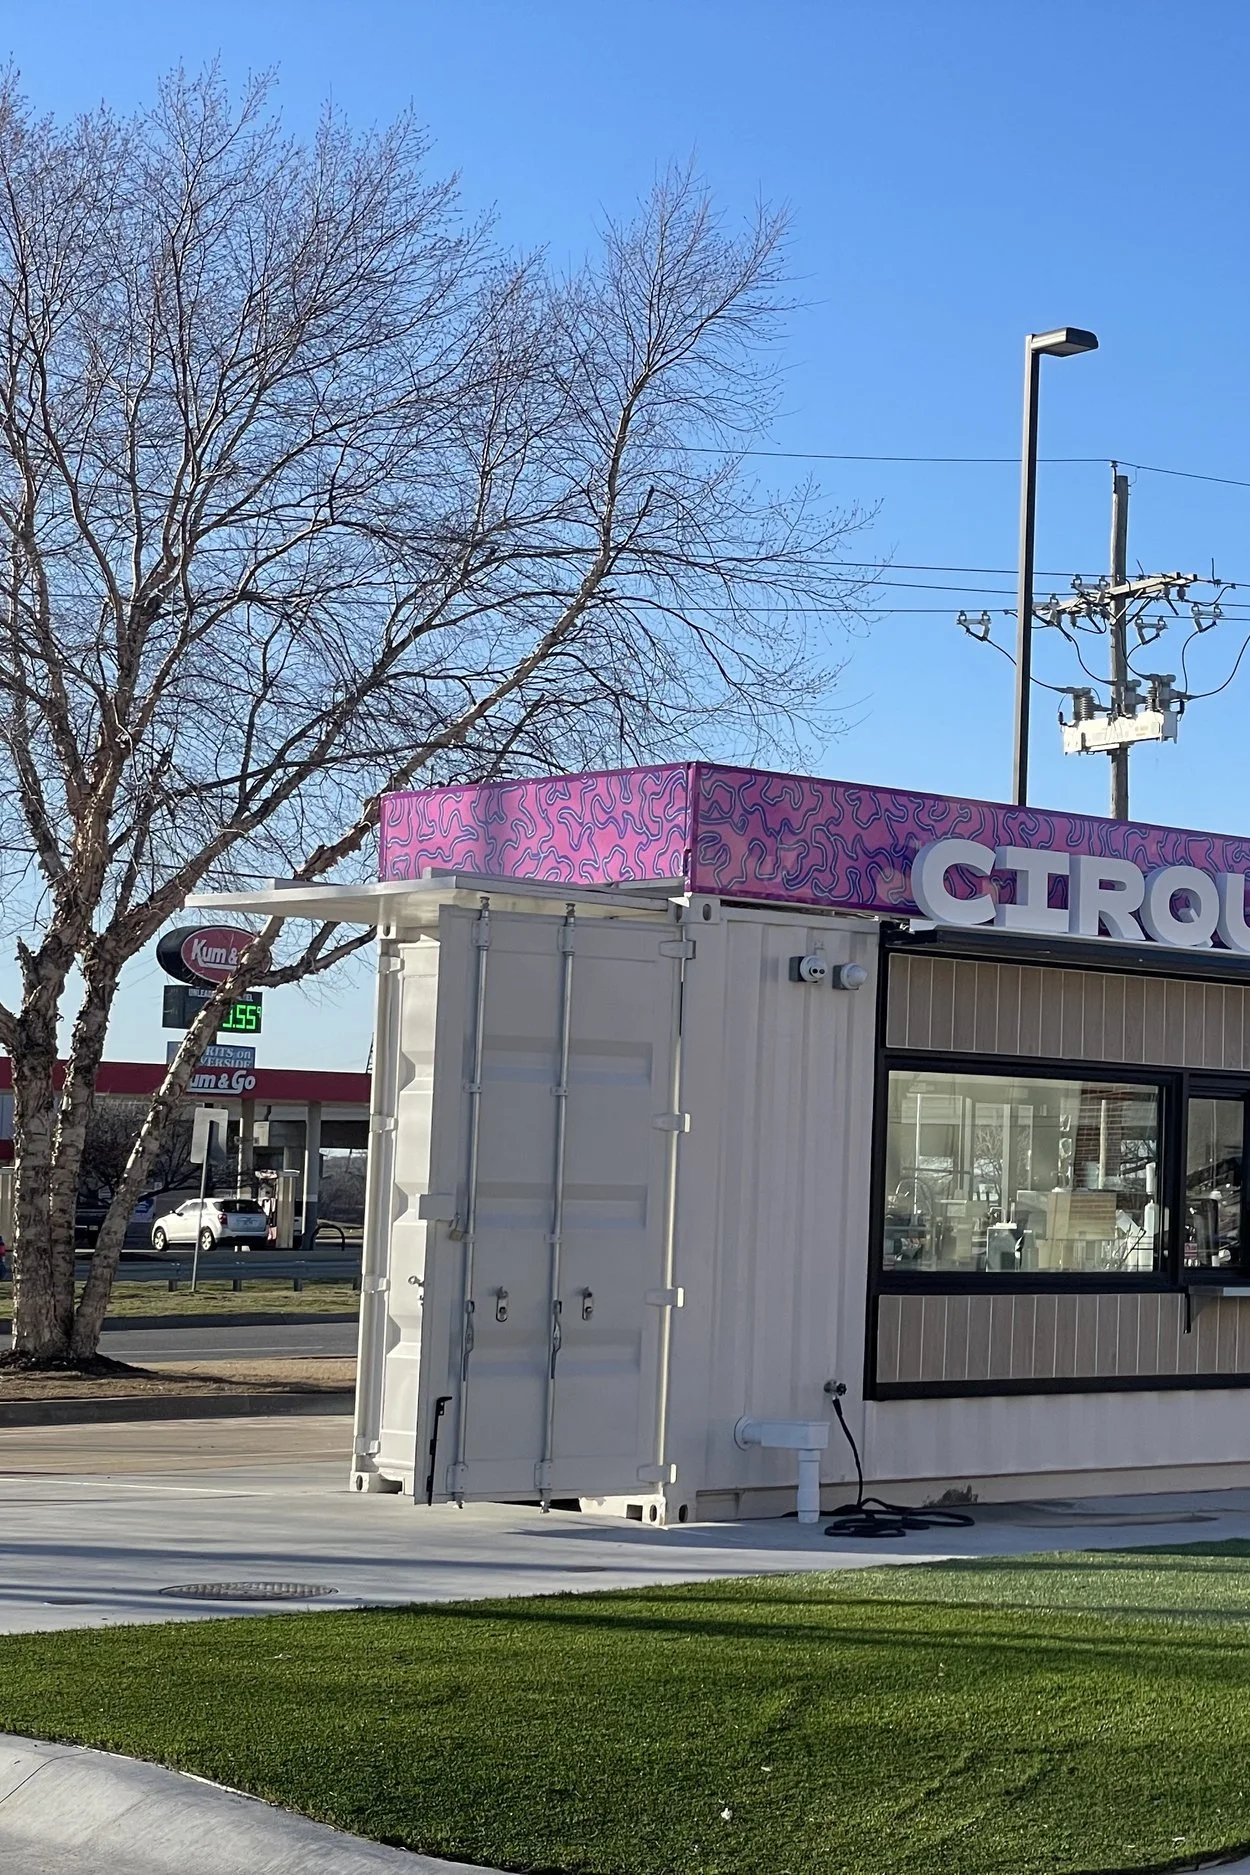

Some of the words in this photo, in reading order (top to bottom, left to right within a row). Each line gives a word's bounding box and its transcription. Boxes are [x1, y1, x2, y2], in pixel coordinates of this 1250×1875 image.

[191, 938, 227, 967] Kum
[188, 987, 214, 998] UNLEAD
[205, 1045, 234, 1058] RITS
[237, 1050, 251, 1059] on
[200, 1056, 252, 1068] VERSIDE
[189, 1073, 217, 1089] um
[218, 1072, 230, 1088] &
[231, 1070, 256, 1094] Go
